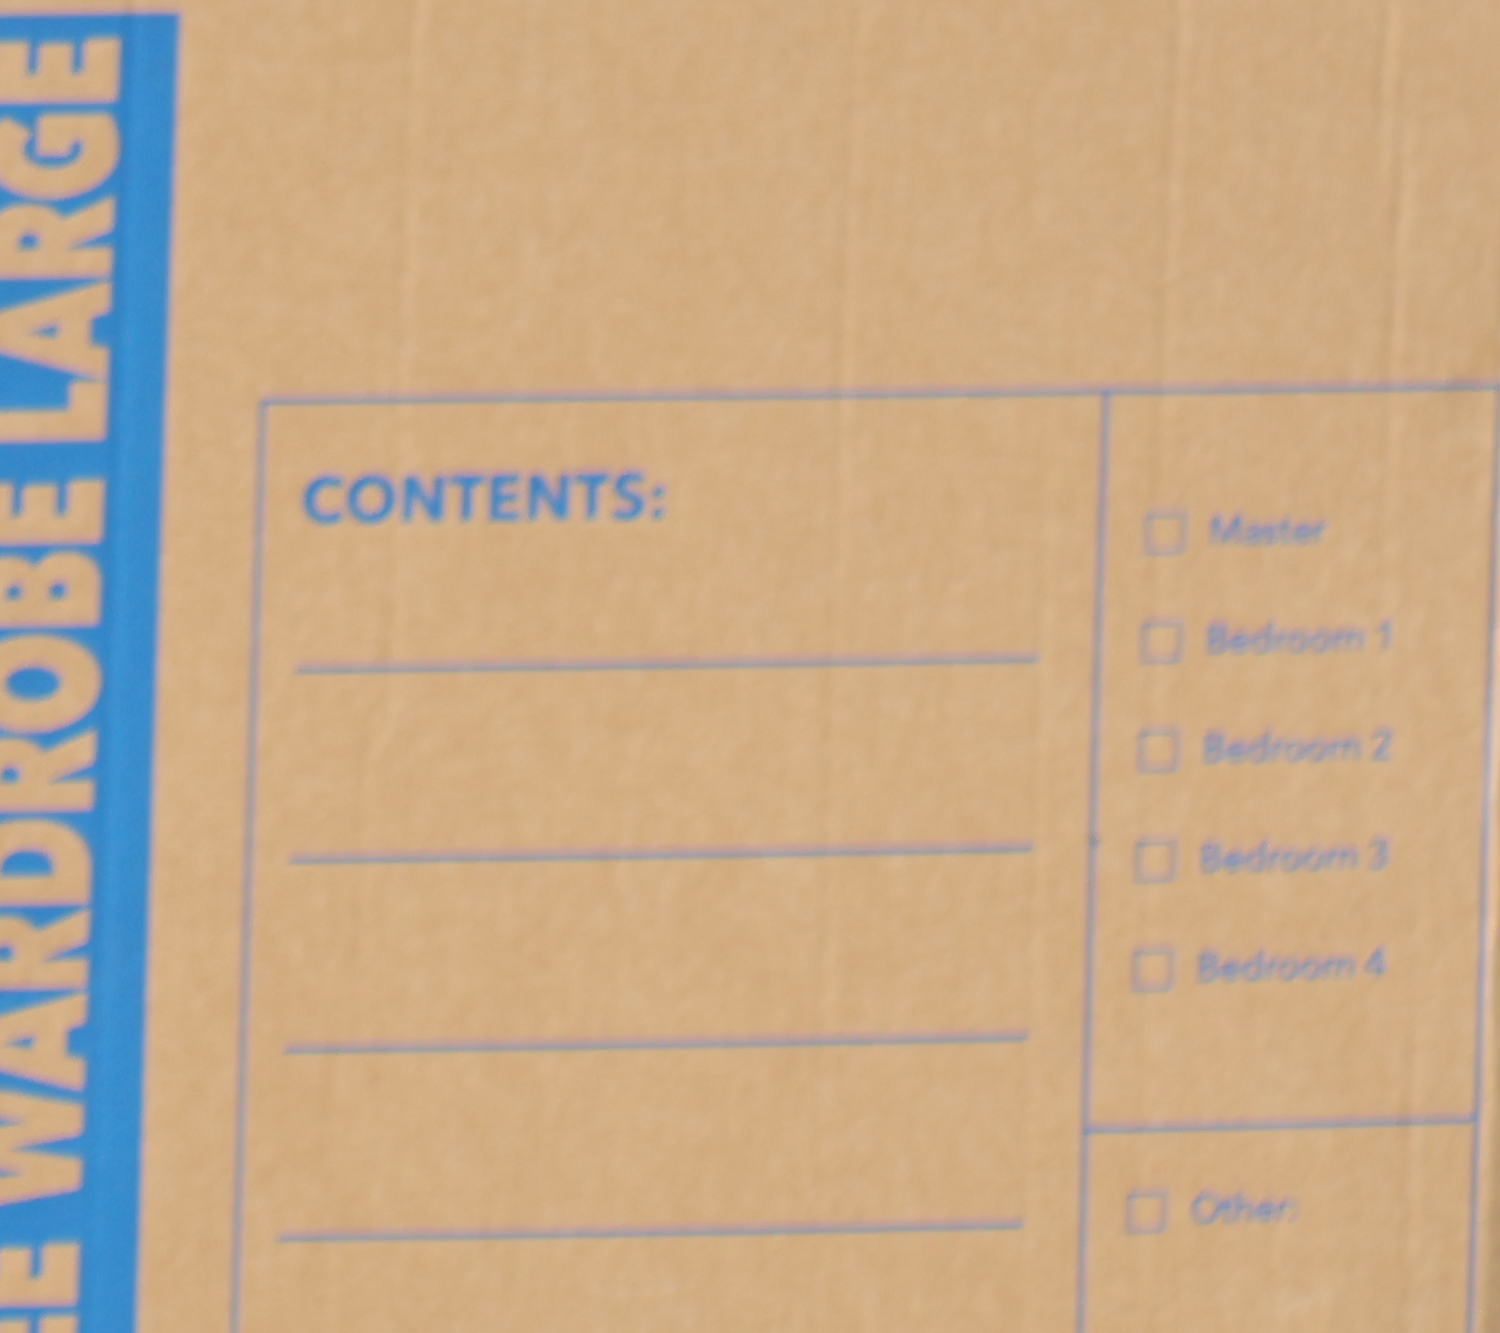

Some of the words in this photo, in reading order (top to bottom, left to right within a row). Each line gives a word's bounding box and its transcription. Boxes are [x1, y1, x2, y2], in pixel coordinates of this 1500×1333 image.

[303, 471, 667, 525] CONTENTS:
[1208, 511, 1326, 547] Master
[1206, 621, 1366, 656] Bedroom
[1377, 619, 1392, 651] 1
[1202, 731, 1362, 765] Bedroom
[1371, 729, 1392, 762] 2
[1199, 841, 1360, 875] Bedroom
[1368, 838, 1390, 872] 3
[1195, 950, 1356, 985] Bedroom
[1365, 947, 1388, 980] 4
